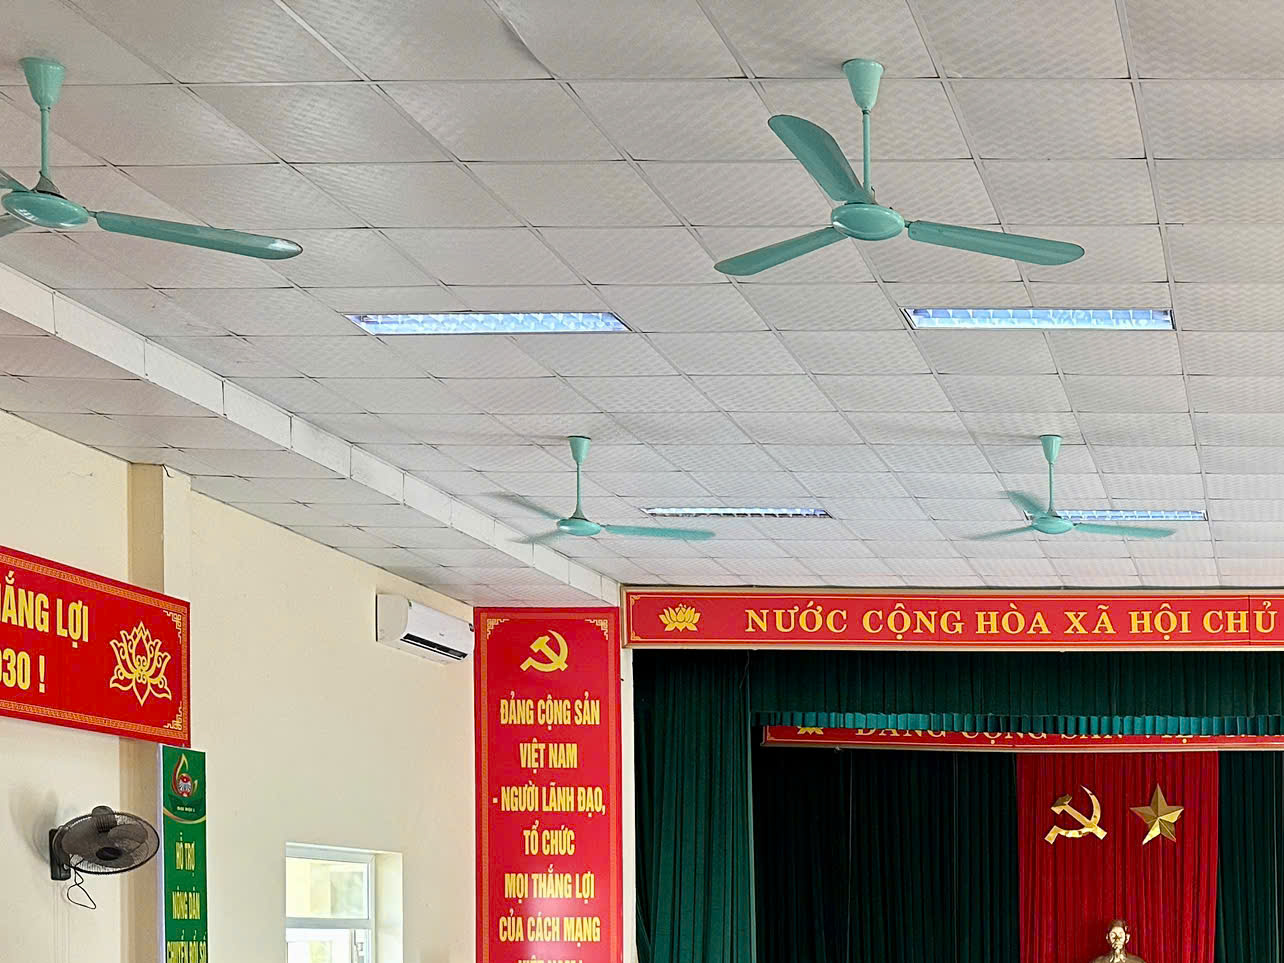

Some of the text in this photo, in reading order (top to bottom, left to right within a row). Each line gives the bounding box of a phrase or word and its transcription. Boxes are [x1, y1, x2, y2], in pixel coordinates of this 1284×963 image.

[0, 570, 89, 648] ẮNG LỢI
[744, 601, 847, 632] NƯỚC
[862, 602, 965, 640] CỘNG
[975, 602, 1051, 634] HÒA
[1064, 603, 1117, 634] XÃ
[1128, 602, 1192, 640] HỘI
[1202, 601, 1277, 633] CHỦ
[0, 648, 46, 693] 30 !
[500, 690, 600, 730] ĐẢNG CỘNG SẢN
[519, 737, 578, 773] VIỆT NAM
[501, 780, 606, 817] NGƯỜI LÃNH ĐẠO,
[523, 819, 575, 855] TỔ CHỨC
[504, 864, 595, 904] MỌI THẮNG LỢI
[499, 908, 601, 947] CỦA CÁCH MẠNG
